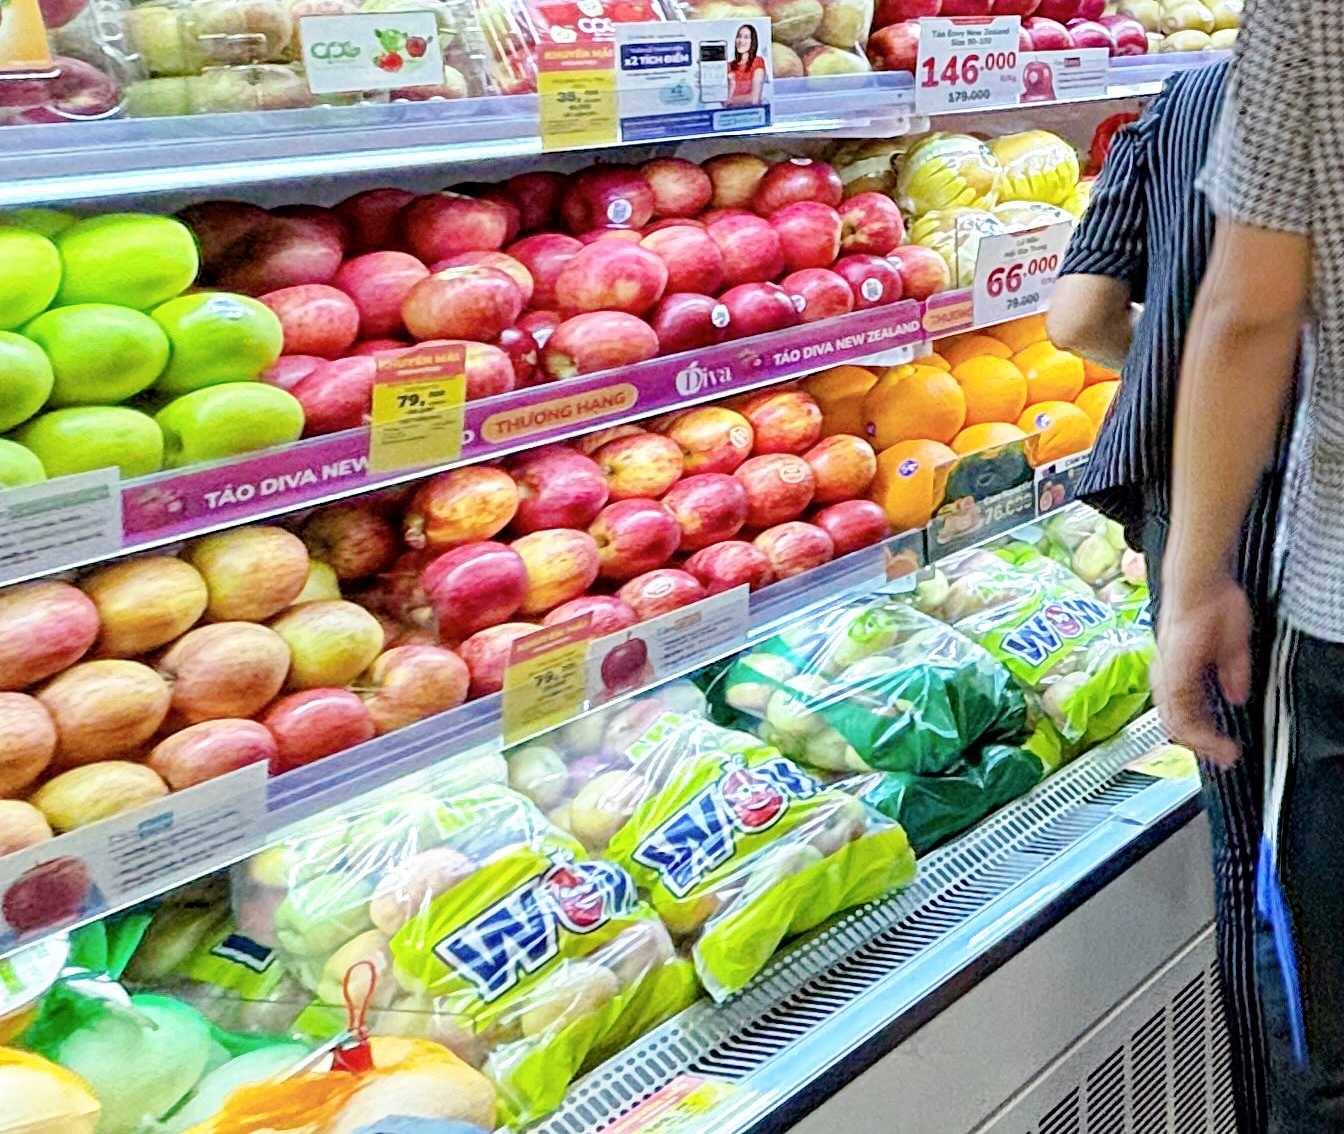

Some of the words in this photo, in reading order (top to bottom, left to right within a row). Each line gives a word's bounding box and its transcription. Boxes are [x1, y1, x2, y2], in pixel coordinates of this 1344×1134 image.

[640, 53, 663, 65] TÍCH
[921, 51, 1016, 88] 146.000
[948, 89, 991, 103] 179.000
[987, 254, 1058, 298] 66.000
[773, 350, 800, 366] TÁO
[802, 344, 834, 360] DIVA
[836, 335, 865, 350] NEW
[867, 320, 920, 344] ZEALAND
[576, 391, 627, 415] HẠNG
[204, 484, 255, 509] TÁO
[260, 471, 318, 496] DIVA
[322, 456, 370, 481] NEW
